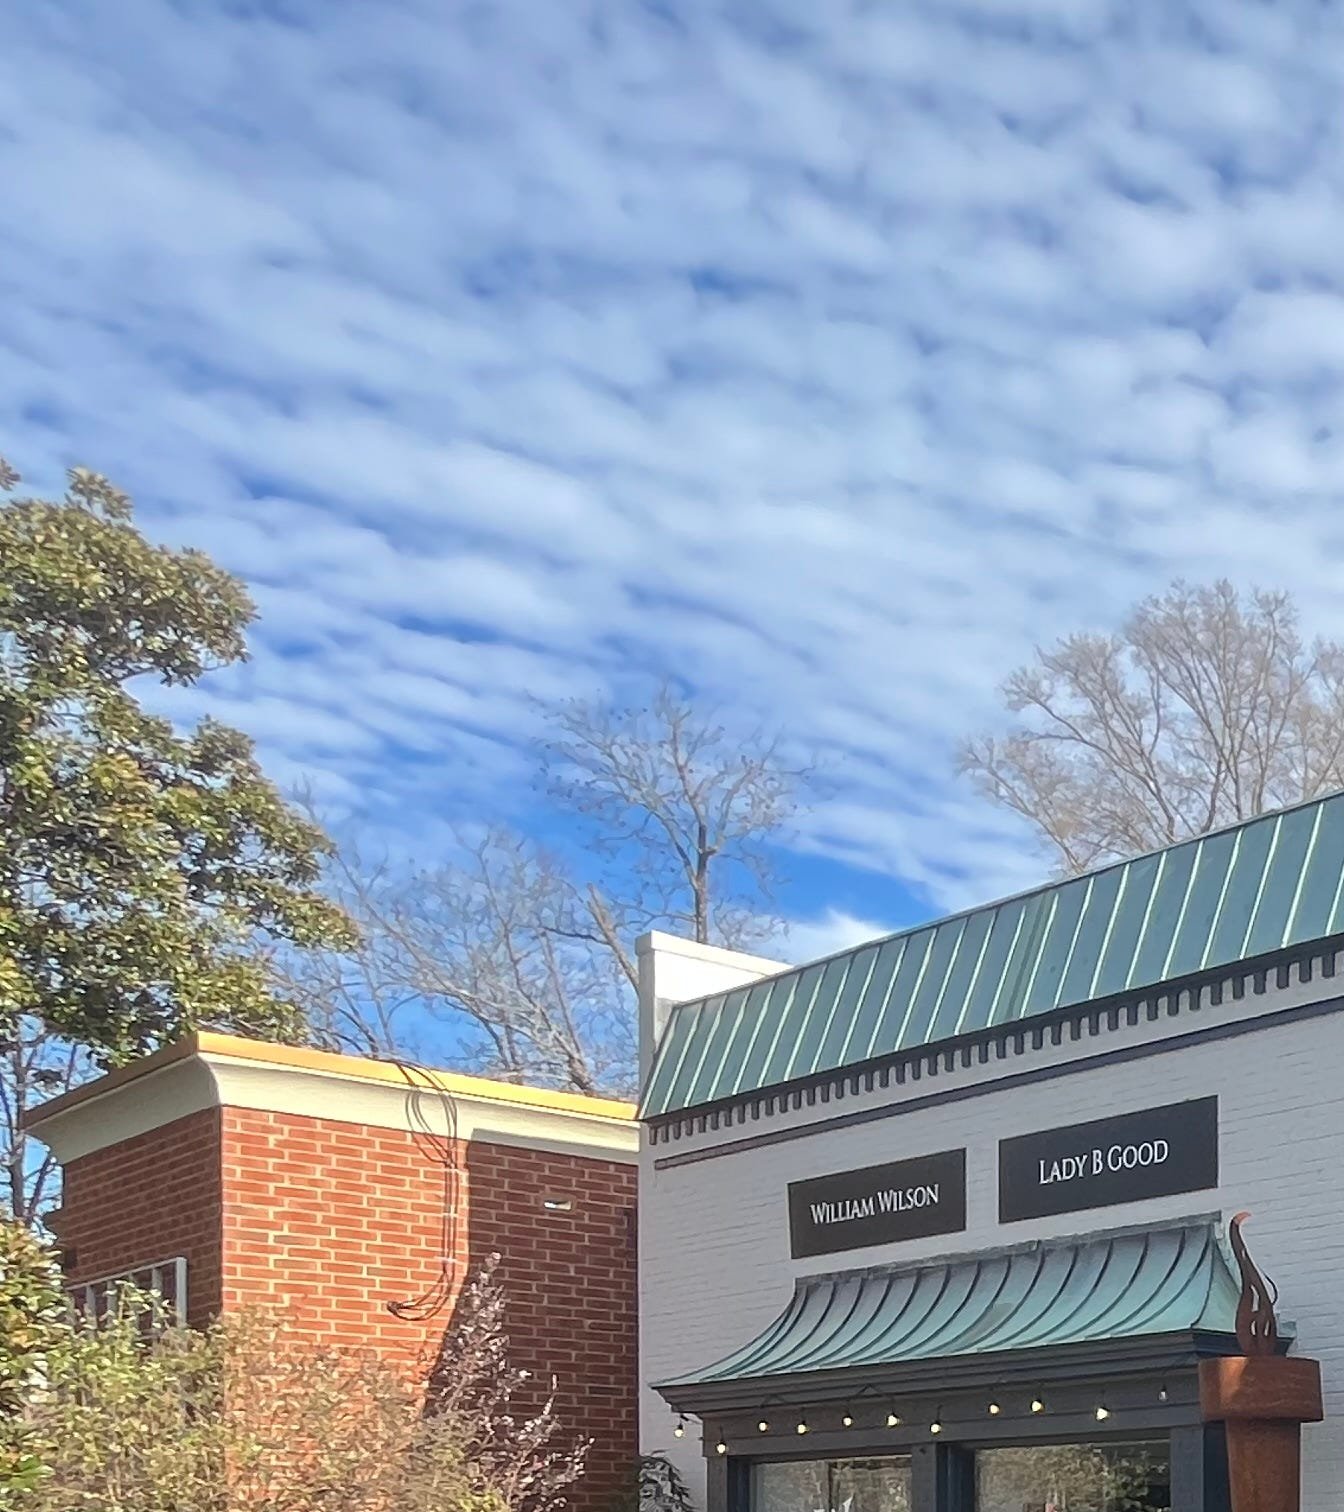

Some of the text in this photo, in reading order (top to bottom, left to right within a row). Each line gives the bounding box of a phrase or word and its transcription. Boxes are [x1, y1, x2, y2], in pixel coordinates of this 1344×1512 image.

[1039, 1140, 1168, 1185] LADY B GOOD
[810, 1183, 939, 1224] WILLIAM WILSON
